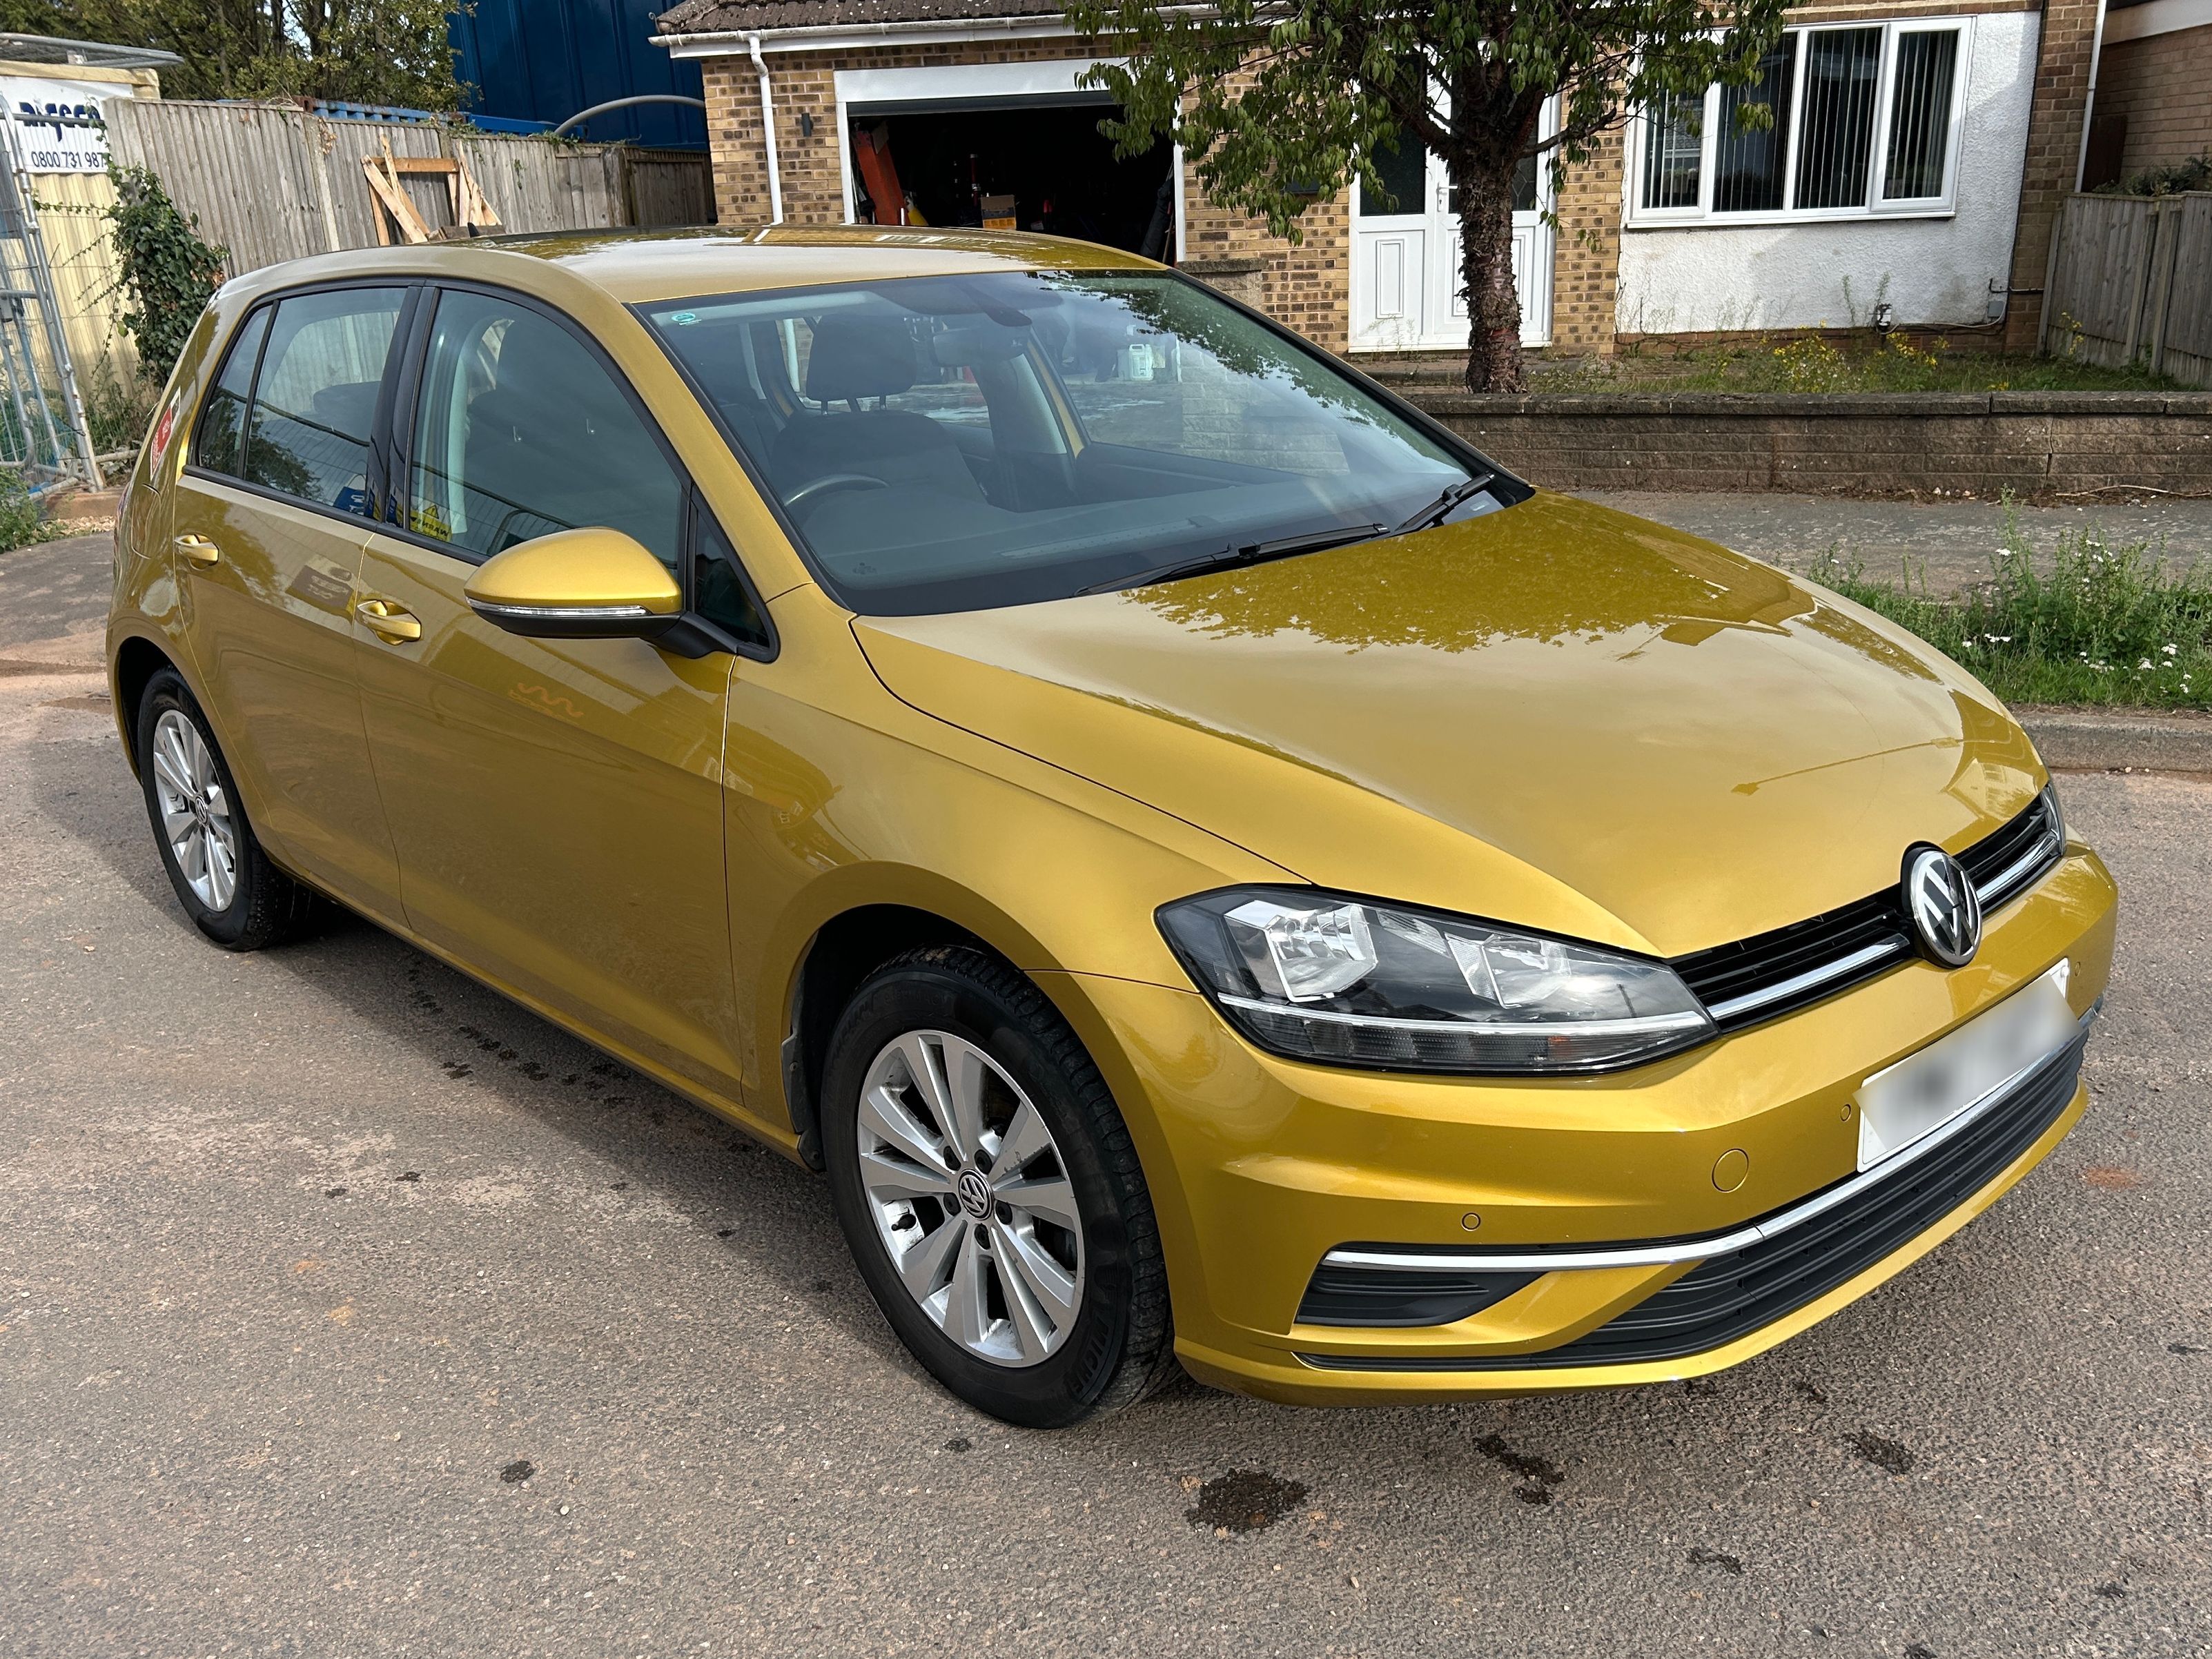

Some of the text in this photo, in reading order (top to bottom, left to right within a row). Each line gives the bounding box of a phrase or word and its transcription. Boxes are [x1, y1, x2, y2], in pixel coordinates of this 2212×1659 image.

[31, 151, 108, 168] 0800 731 987
[1911, 851, 1982, 966] VW
[959, 1171, 991, 1219] VW
